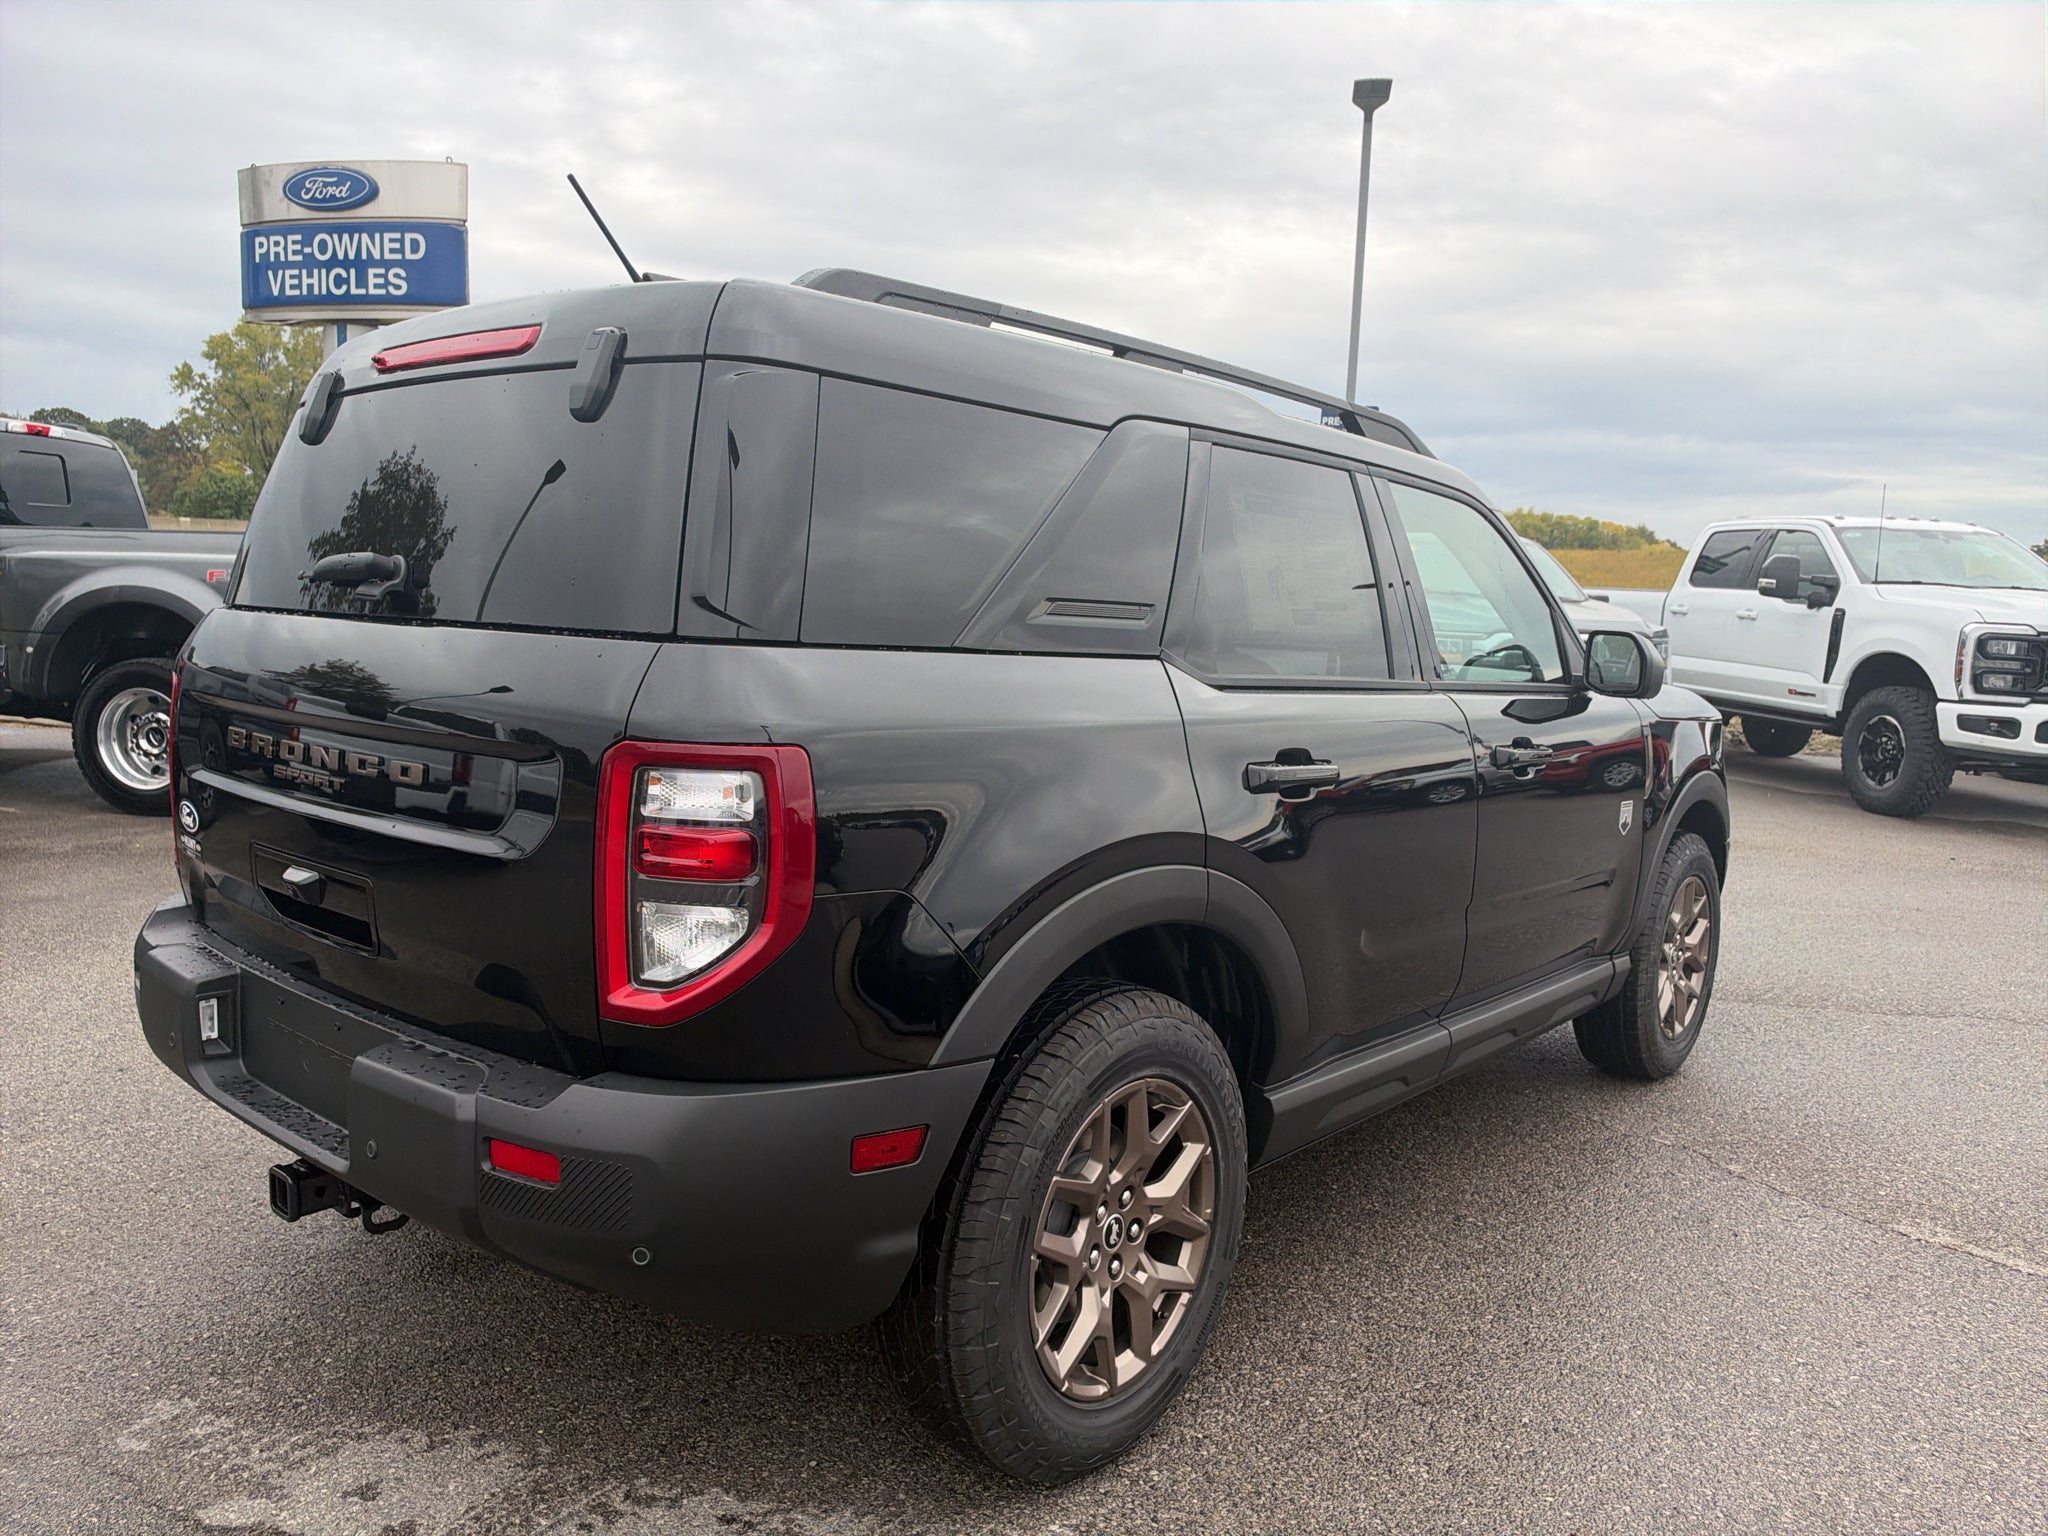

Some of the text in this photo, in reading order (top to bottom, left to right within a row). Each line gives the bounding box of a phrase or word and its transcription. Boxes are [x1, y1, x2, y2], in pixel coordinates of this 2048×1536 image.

[301, 176, 352, 200] Ford
[254, 232, 426, 263] PRE-OWNED
[268, 267, 408, 296] VEHICLES
[227, 725, 426, 785] BRONCO
[273, 764, 346, 791] SPORT
